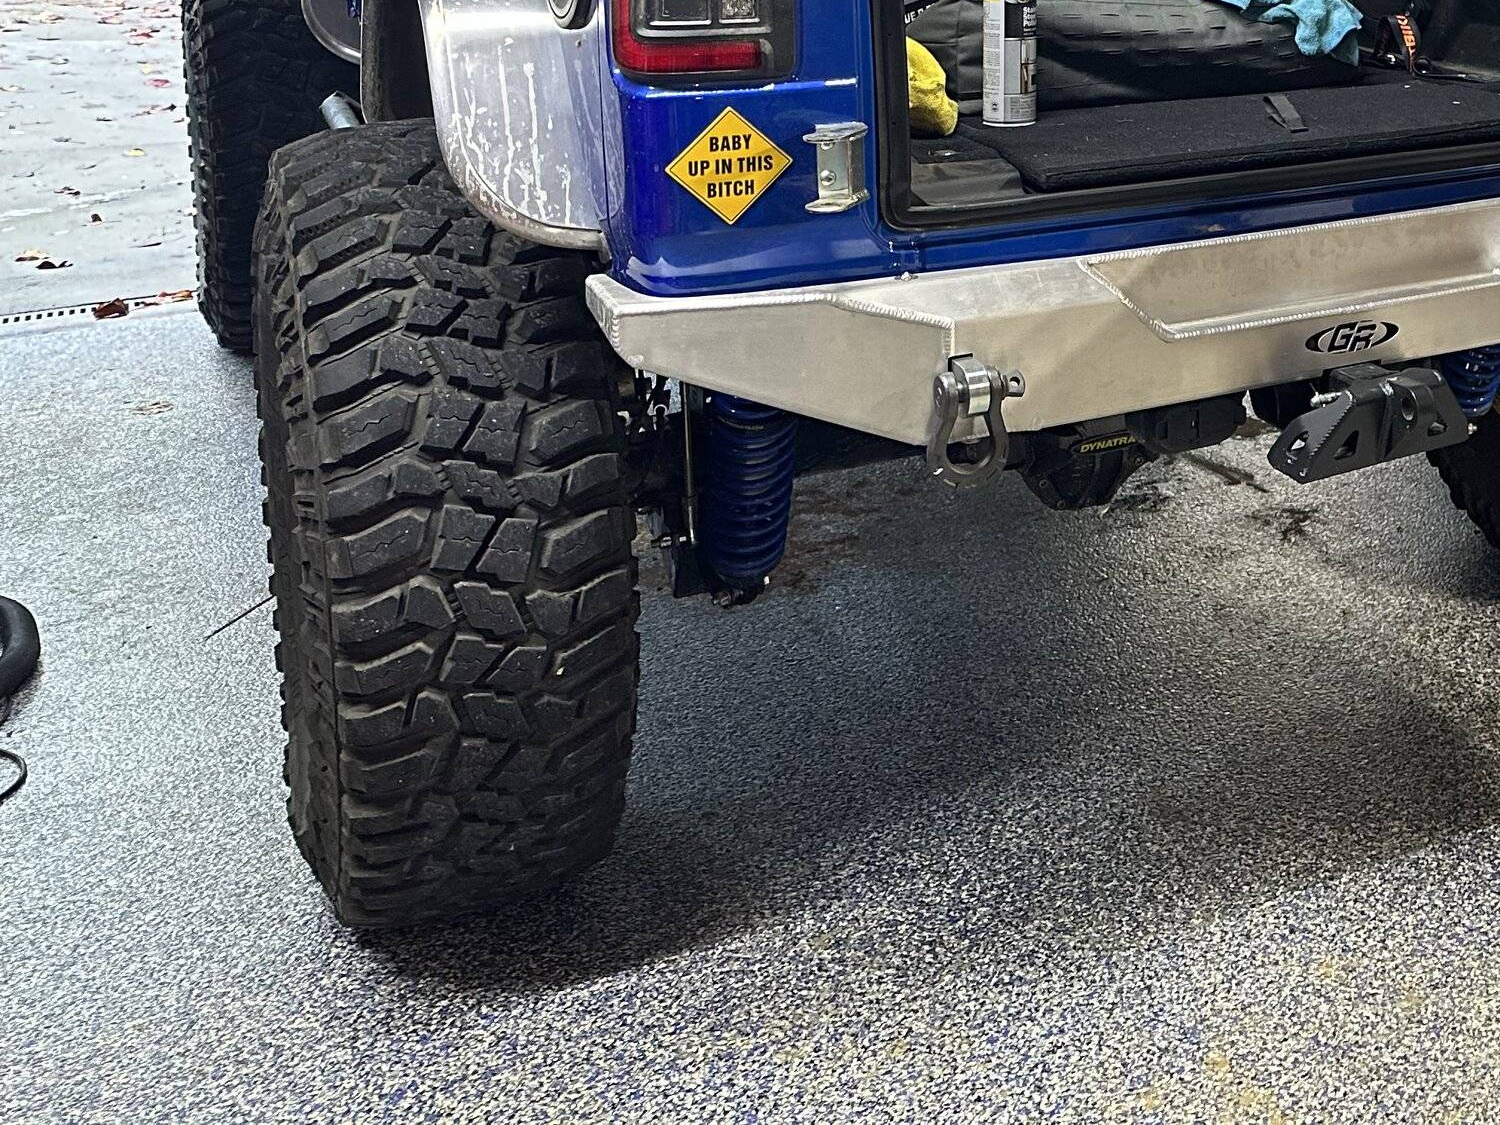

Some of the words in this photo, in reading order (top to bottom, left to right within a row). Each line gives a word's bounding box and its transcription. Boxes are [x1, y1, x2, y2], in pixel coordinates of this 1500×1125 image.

[709, 134, 752, 152] BABY
[688, 160, 710, 176] UP
[715, 158, 732, 175] IN
[737, 155, 774, 173] THIS
[707, 179, 755, 198] BITCH
[1080, 435, 1137, 453] DYNATRA
